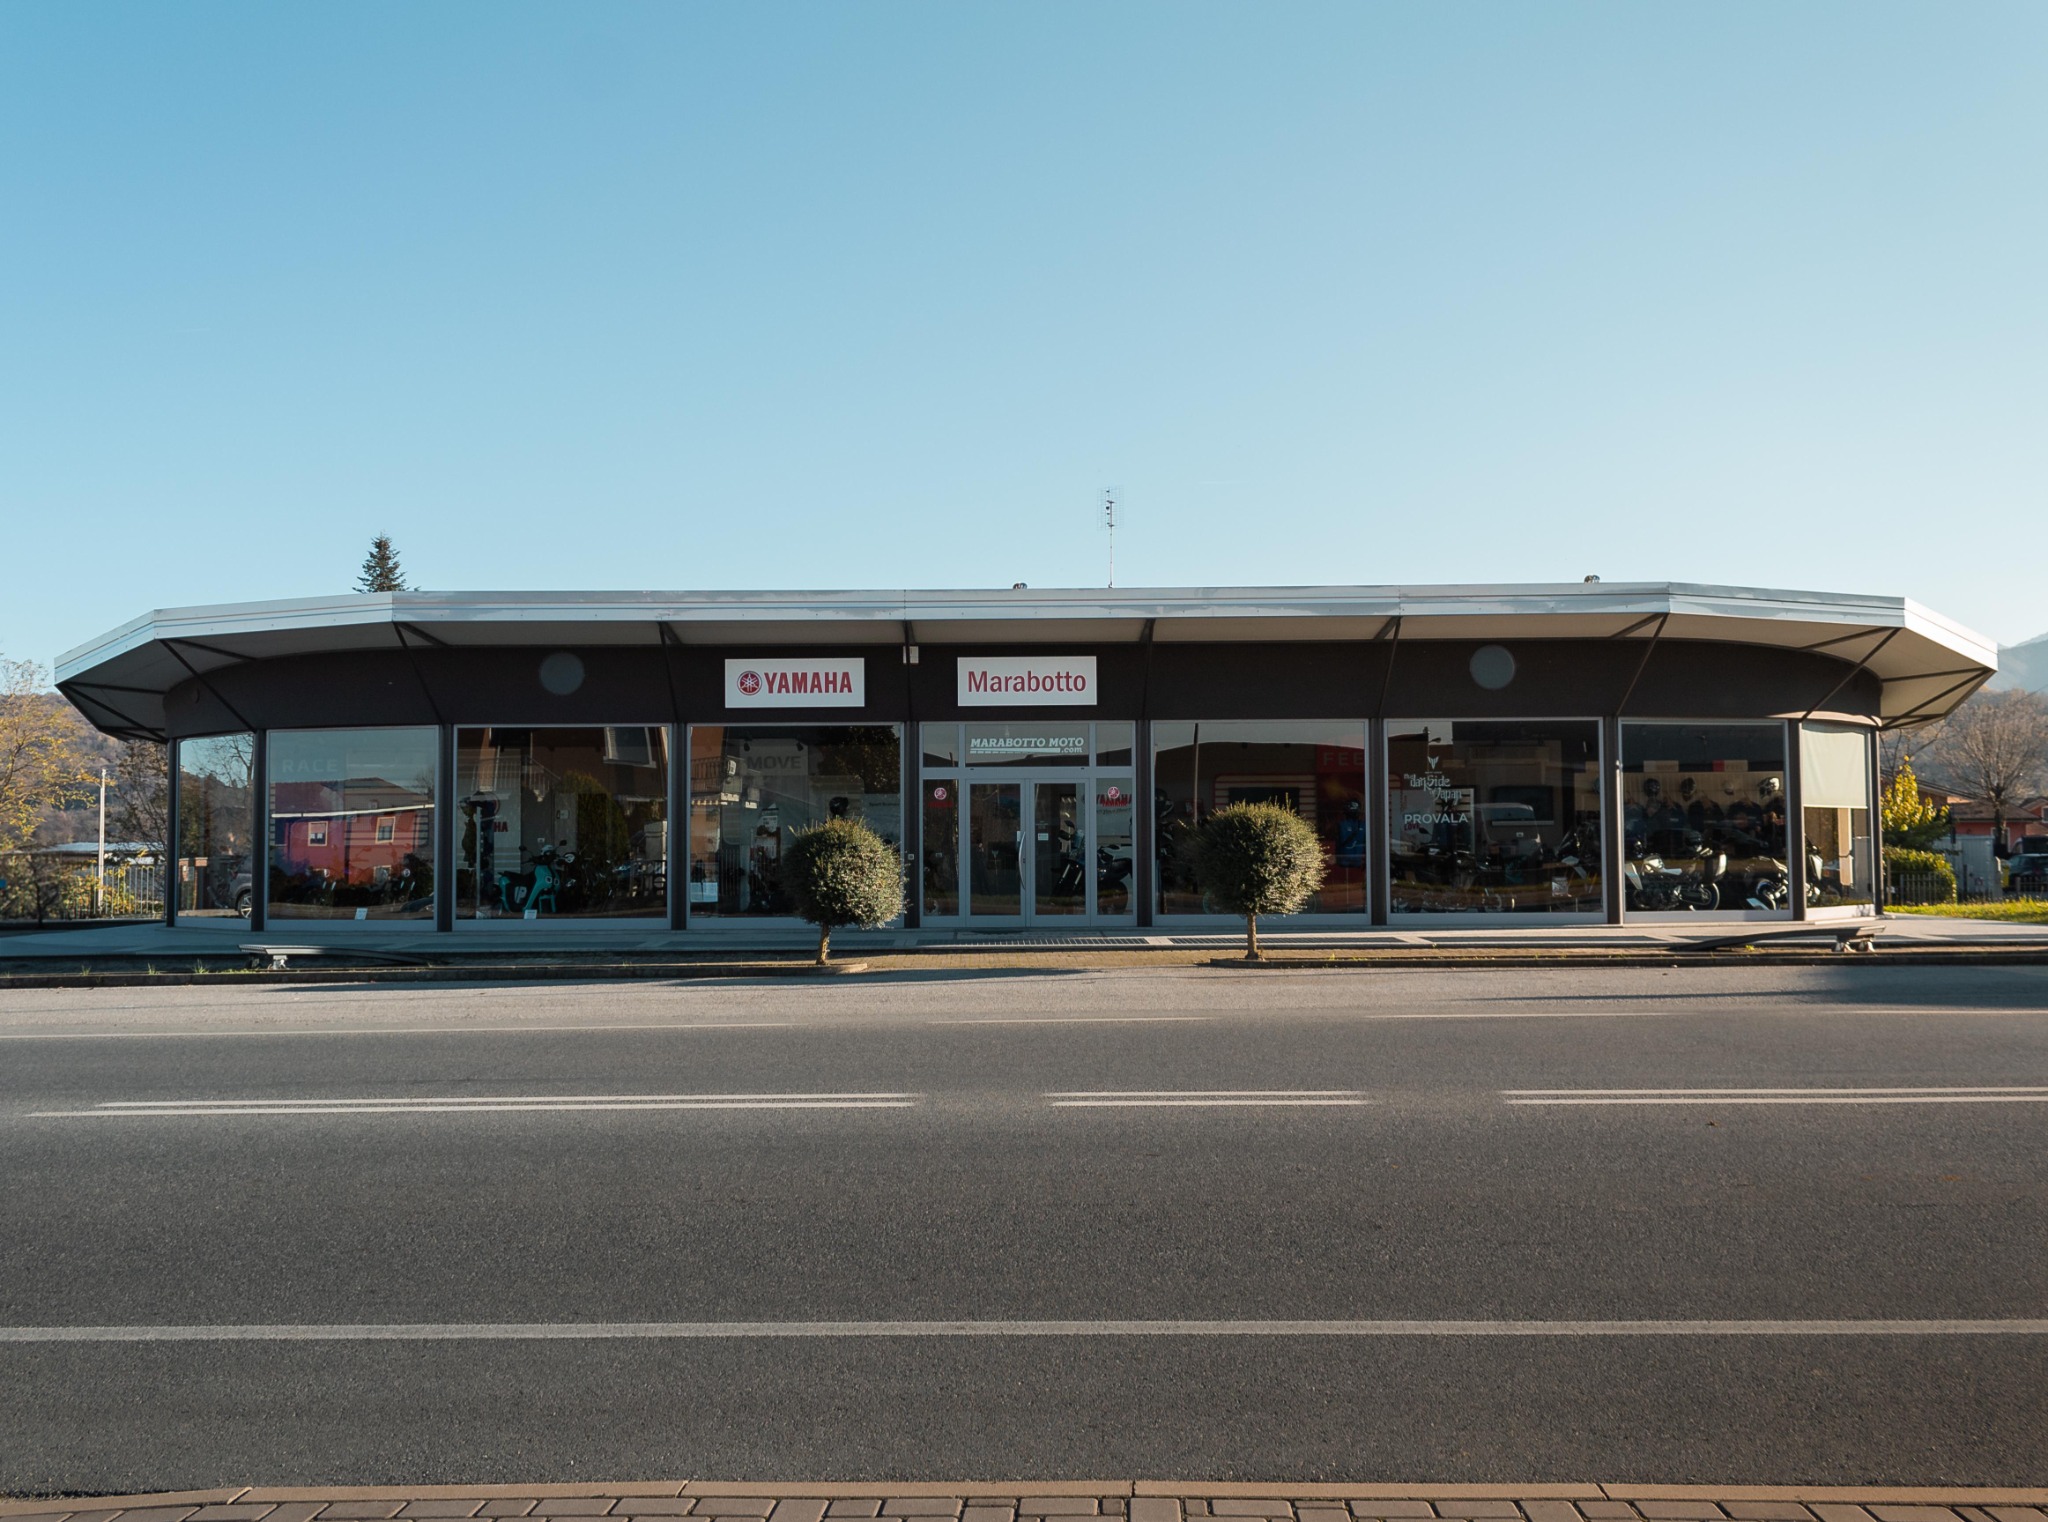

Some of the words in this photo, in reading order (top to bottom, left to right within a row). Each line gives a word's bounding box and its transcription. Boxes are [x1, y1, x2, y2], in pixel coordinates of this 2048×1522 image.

[764, 672, 853, 694] YAMAHA
[968, 671, 1086, 692] Marabotto
[970, 738, 1046, 748] MARABOTTO
[1048, 737, 1084, 747] MOTO
[282, 759, 338, 773] RACE
[747, 756, 802, 769] MOVE
[1404, 813, 1469, 824] PROVALA
